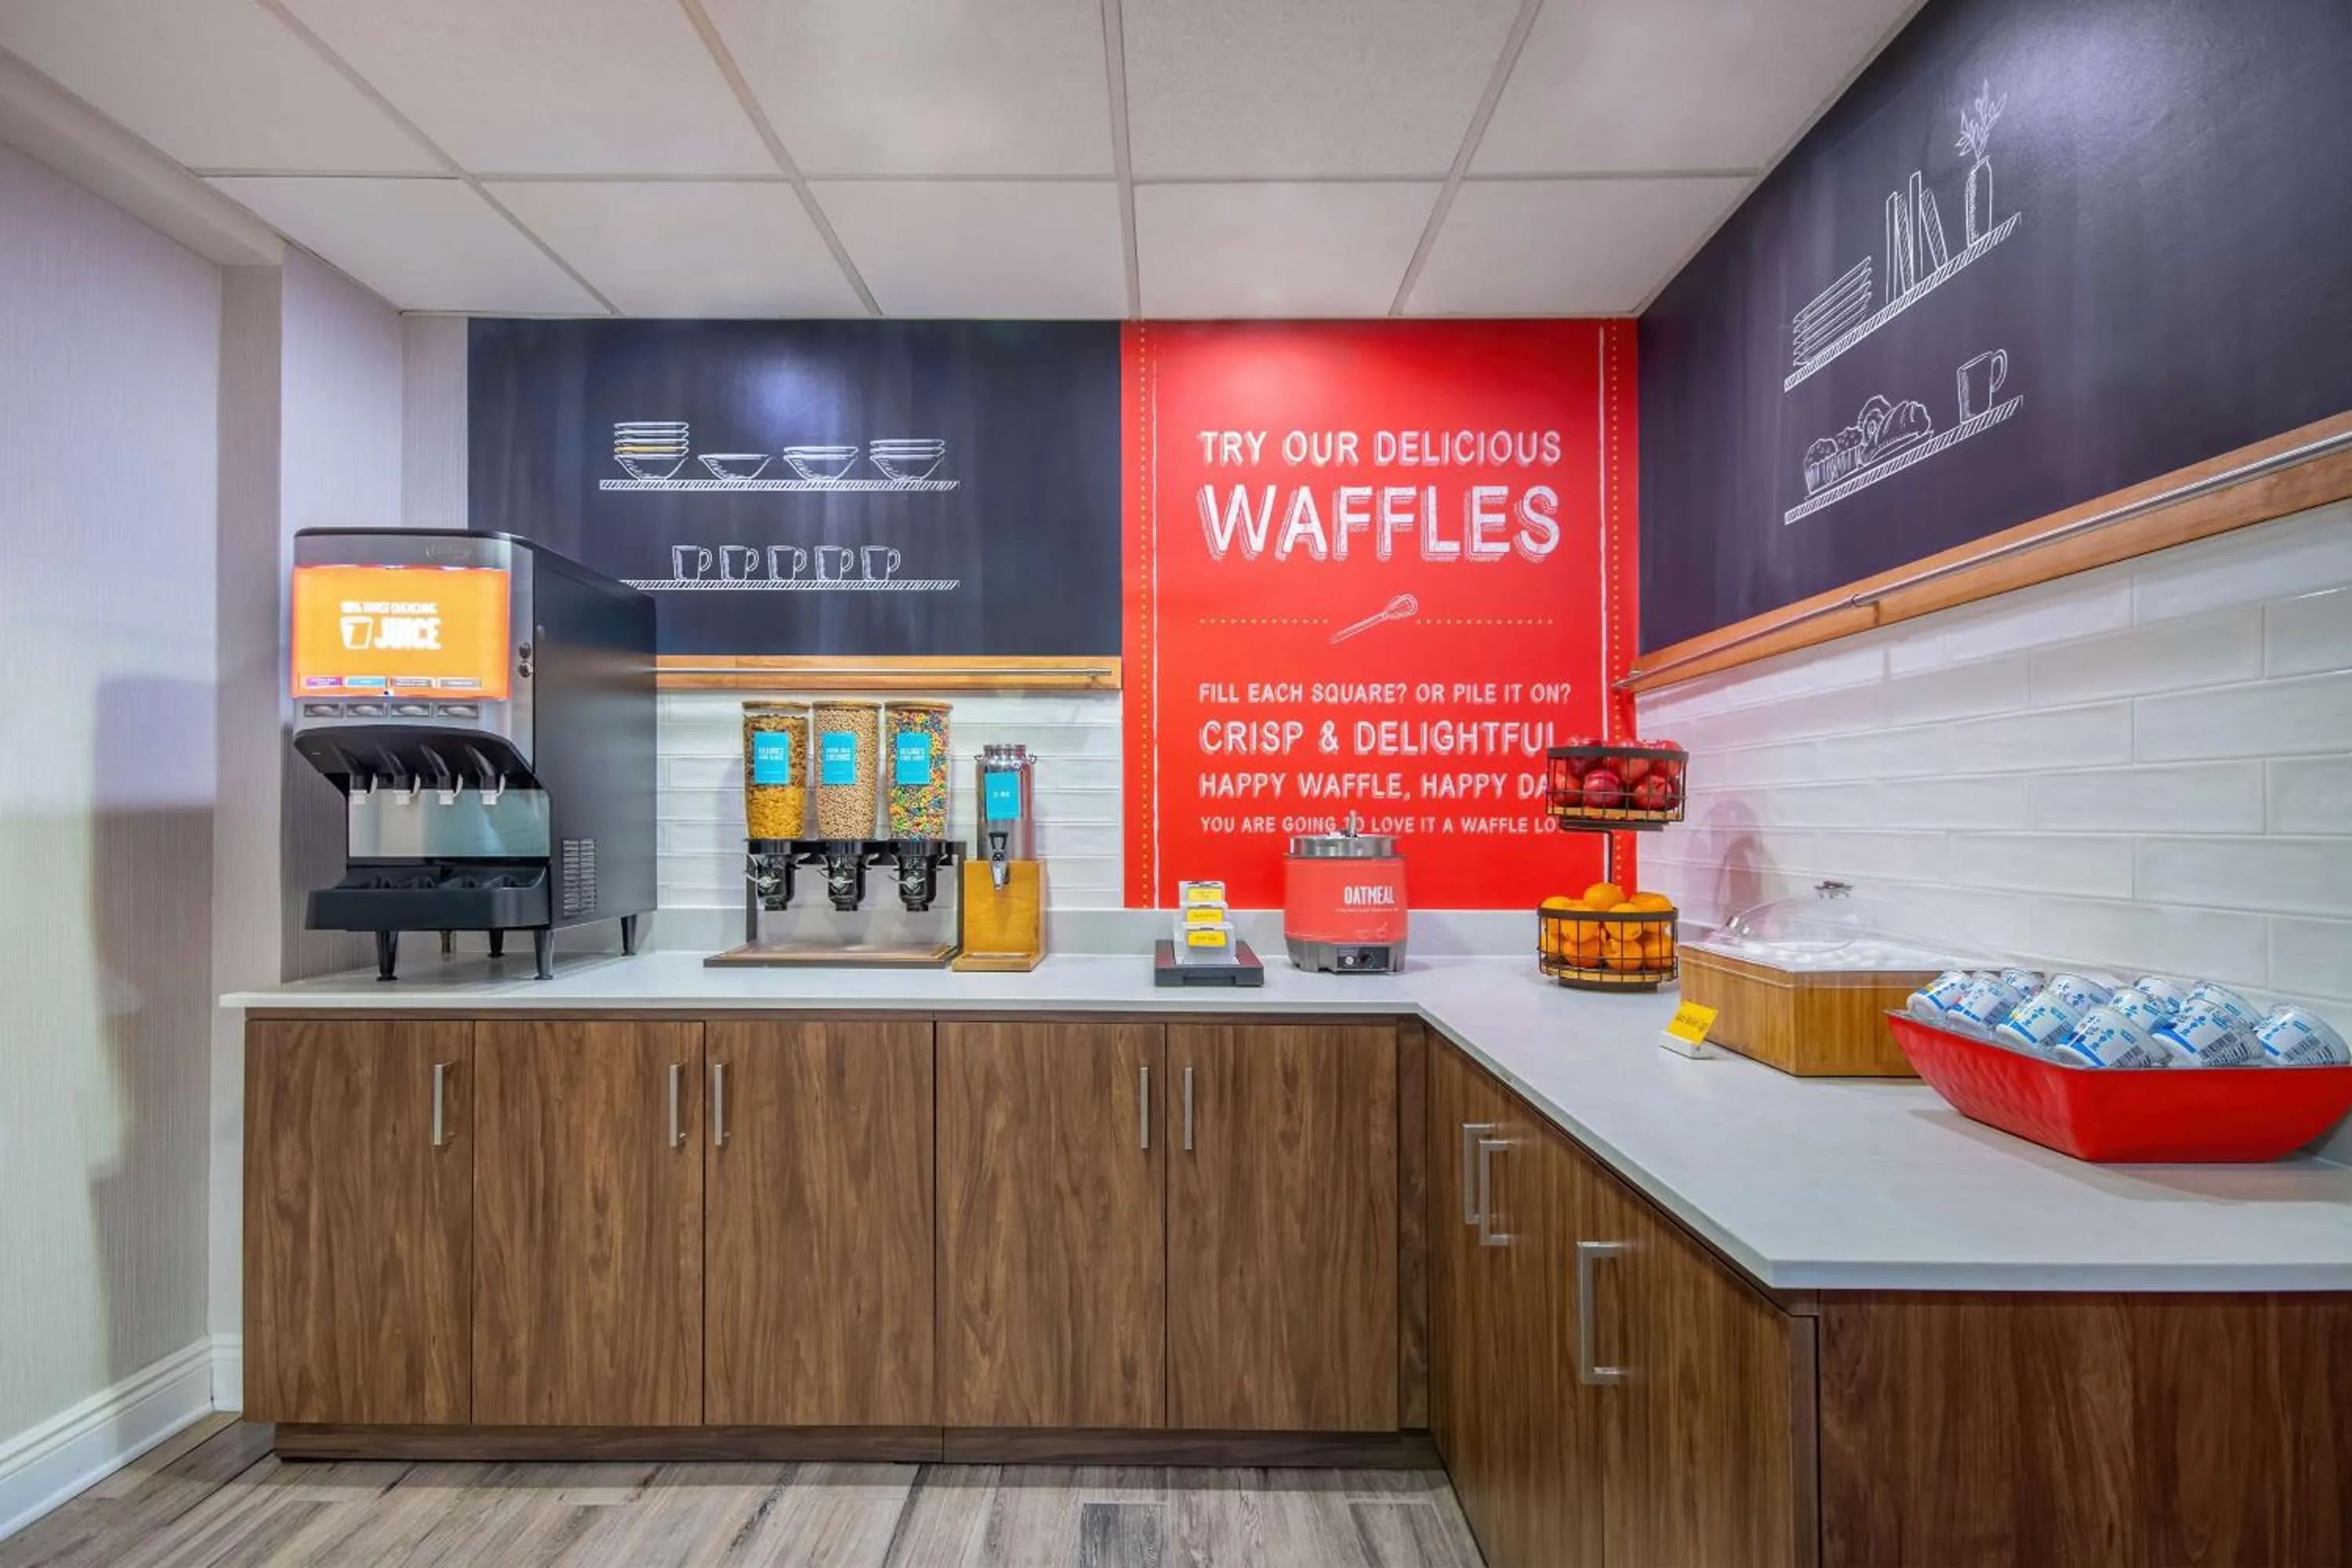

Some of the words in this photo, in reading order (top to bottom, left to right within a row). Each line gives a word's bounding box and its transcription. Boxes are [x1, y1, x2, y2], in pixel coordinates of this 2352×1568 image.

[1197, 430, 1268, 466] TRY
[1283, 430, 1360, 466] OUR
[1372, 430, 1562, 466] DELICIOUS
[1196, 484, 1561, 564] WAFFLES
[373, 616, 442, 651] JUICE
[1199, 683, 1240, 703] FILL
[1247, 683, 1303, 703] EACH
[1311, 682, 1407, 704] SQUARE?
[1415, 683, 1445, 703] OR
[1453, 683, 1497, 704] PILE
[1504, 684, 1523, 704] IT
[1530, 683, 1572, 703] ON?
[1199, 720, 1304, 754] CRISP
[1317, 720, 1340, 754] &
[1199, 772, 1287, 798] HAPPY
[1298, 772, 1410, 800] WAFFLE,
[1421, 772, 1508, 800] HAPPY
[1518, 773, 1548, 800] DA
[1200, 816, 1235, 833] YOU
[1242, 816, 1276, 833] ARE
[1282, 816, 1337, 833] GOING
[1371, 817, 1415, 833] LOVE
[1420, 817, 1436, 833] IT
[1442, 817, 1454, 833] A
[1461, 817, 1528, 833] WAFFLE
[1534, 817, 1561, 833] LO
[1344, 886, 1395, 905] OATMEAL
